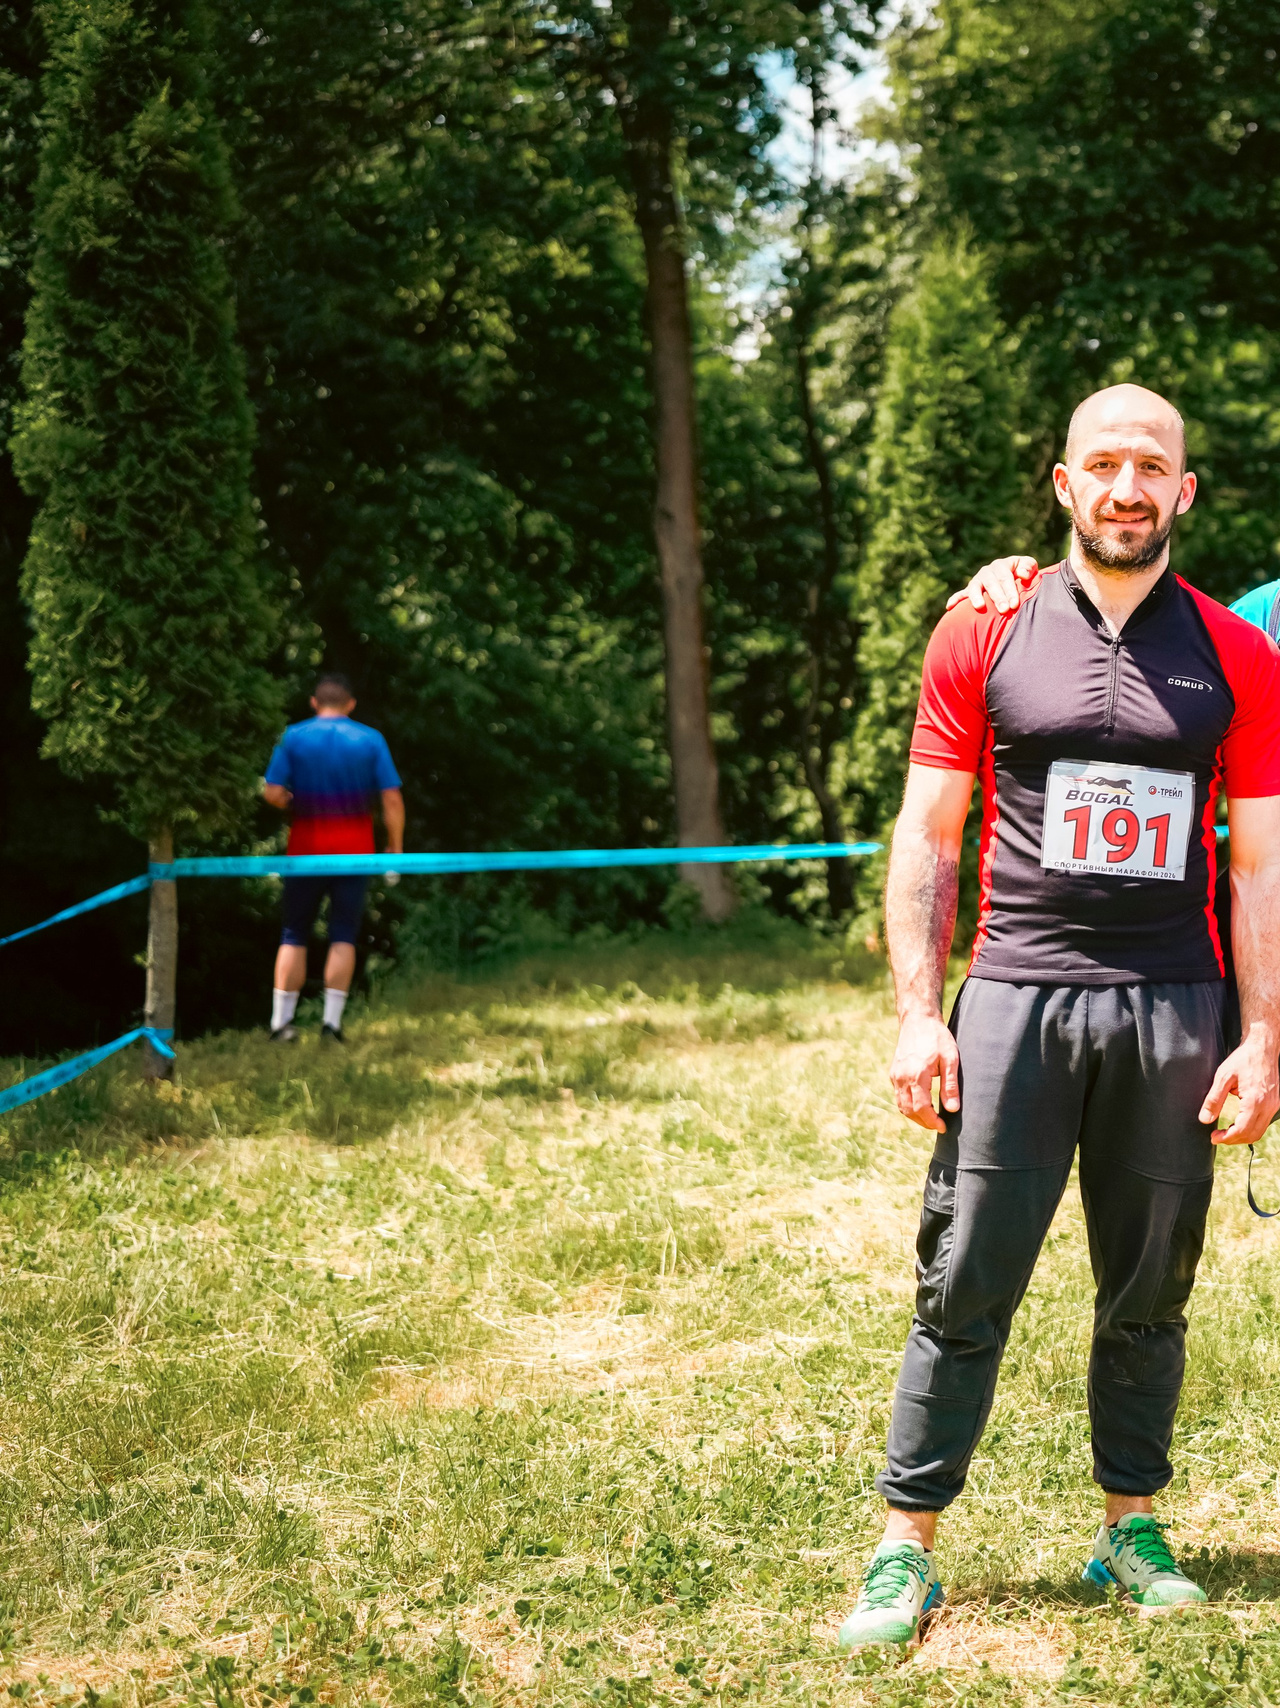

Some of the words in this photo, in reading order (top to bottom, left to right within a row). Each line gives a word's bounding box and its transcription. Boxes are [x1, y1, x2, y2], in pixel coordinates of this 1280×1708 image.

[1167, 677, 1204, 690] COMUS
[1065, 789, 1134, 807] BOGAL
[1063, 804, 1171, 868] 191
[1054, 861, 1114, 873] СПОРТИВНЫЙ
[1115, 867, 1159, 877] МАРАФОН
